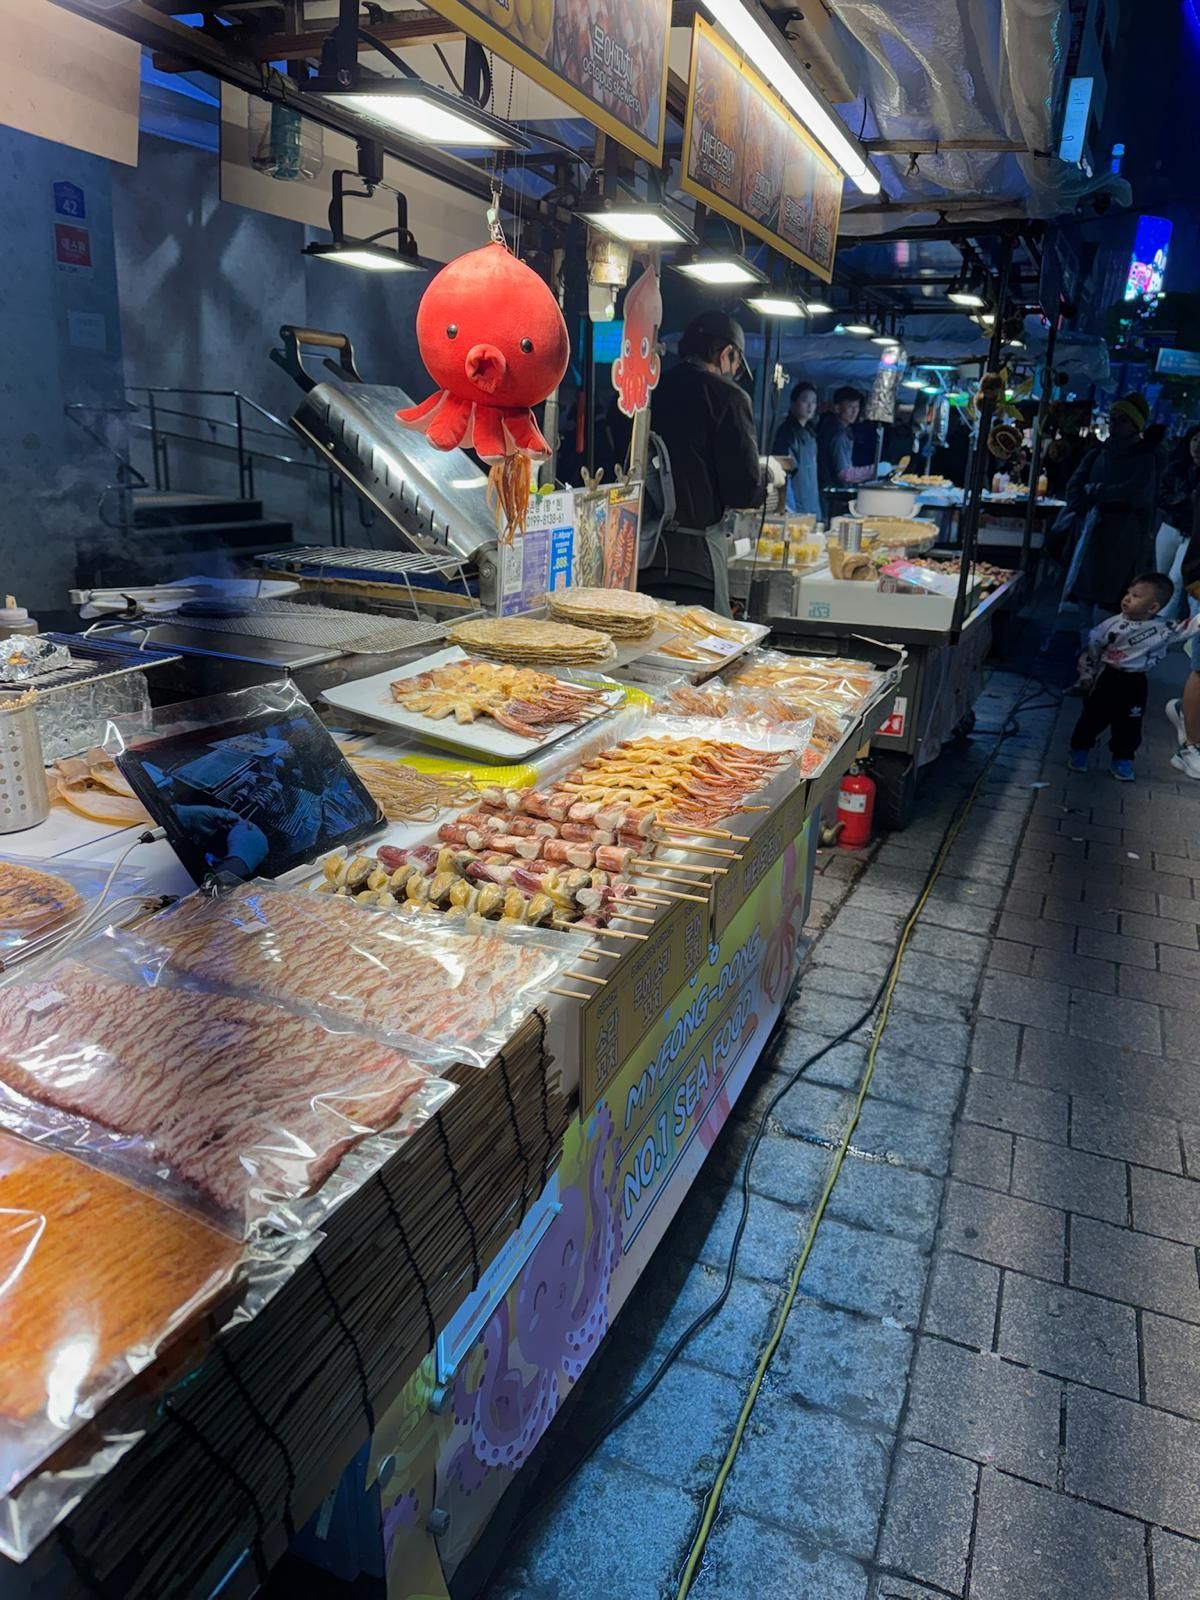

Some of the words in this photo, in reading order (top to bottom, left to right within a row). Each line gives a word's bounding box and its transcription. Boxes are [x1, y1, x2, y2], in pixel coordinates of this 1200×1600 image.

[592, 24, 634, 85] 문어꼬치
[583, 56, 613, 92] octopus
[613, 81, 641, 113] skewers
[702, 128, 736, 174] 버터오징어
[62, 199, 79, 215] 42
[624, 921, 762, 1130] MYEONG-DONG
[623, 1111, 669, 1220] NO.1
[674, 1056, 710, 1137] SEA
[711, 988, 754, 1074] FOOD
